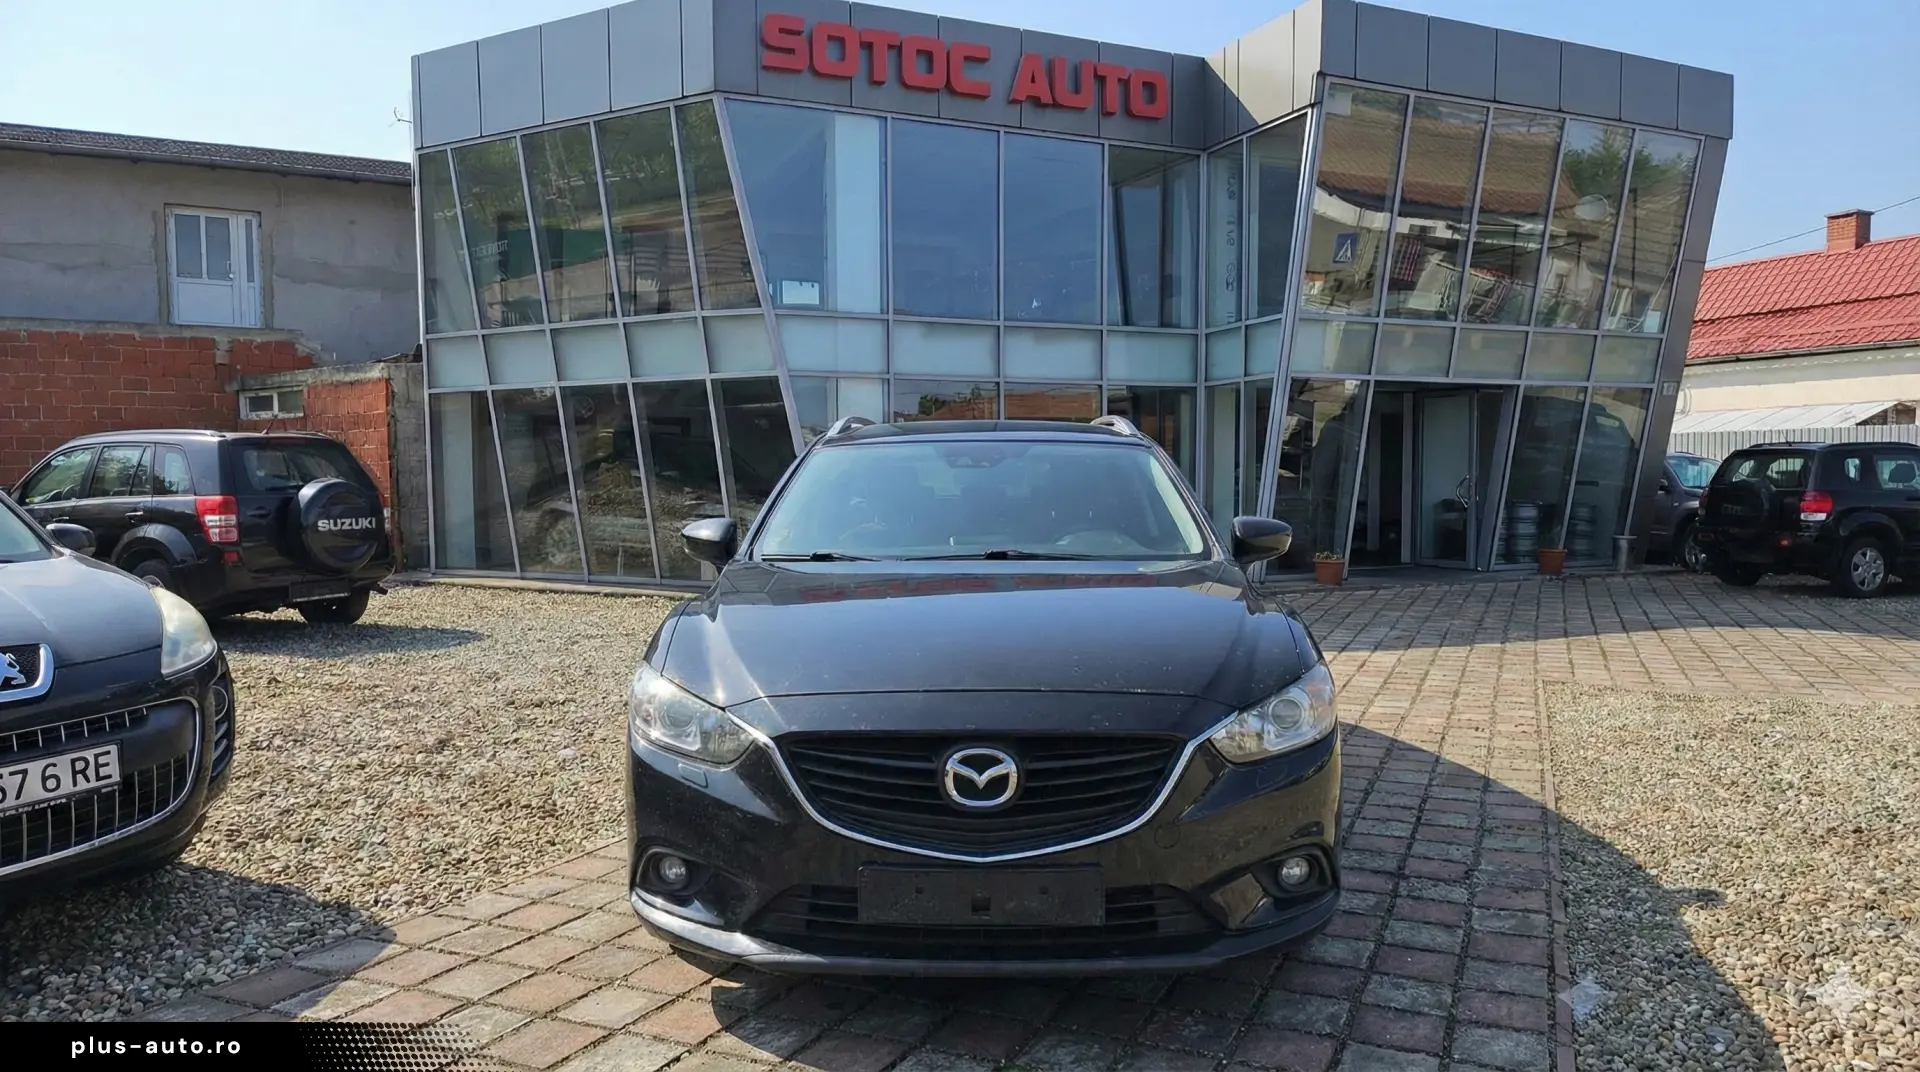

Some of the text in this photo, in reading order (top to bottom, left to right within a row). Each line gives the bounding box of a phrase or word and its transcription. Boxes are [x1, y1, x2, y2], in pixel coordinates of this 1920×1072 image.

[762, 13, 1169, 119] SOTOC AUTO
[317, 517, 376, 531] SUZUKI
